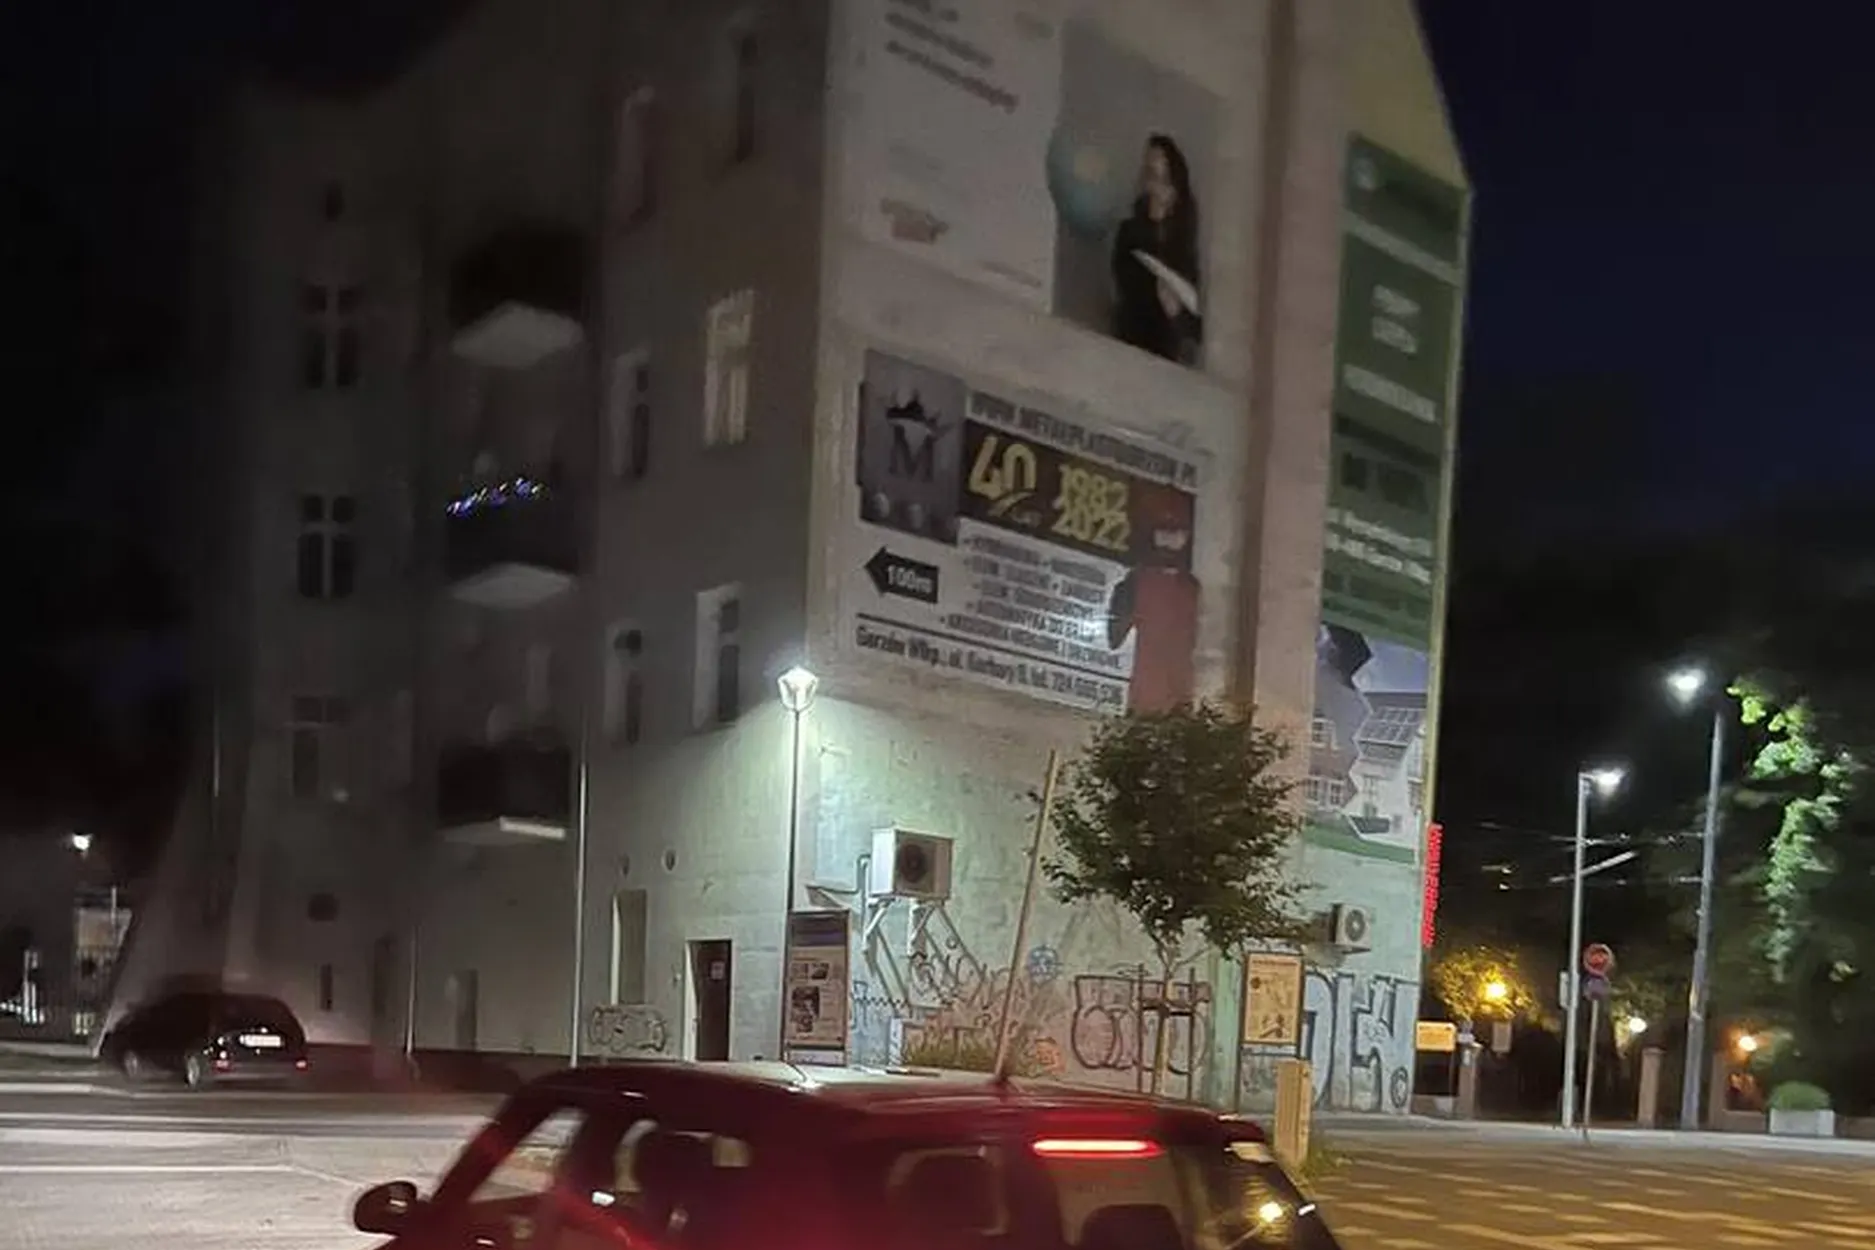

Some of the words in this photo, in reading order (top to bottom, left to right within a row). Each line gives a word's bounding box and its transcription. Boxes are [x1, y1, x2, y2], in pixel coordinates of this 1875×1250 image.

[969, 436, 1036, 500] 40
[1056, 464, 1129, 517] 1982
[888, 564, 932, 594] 100m
